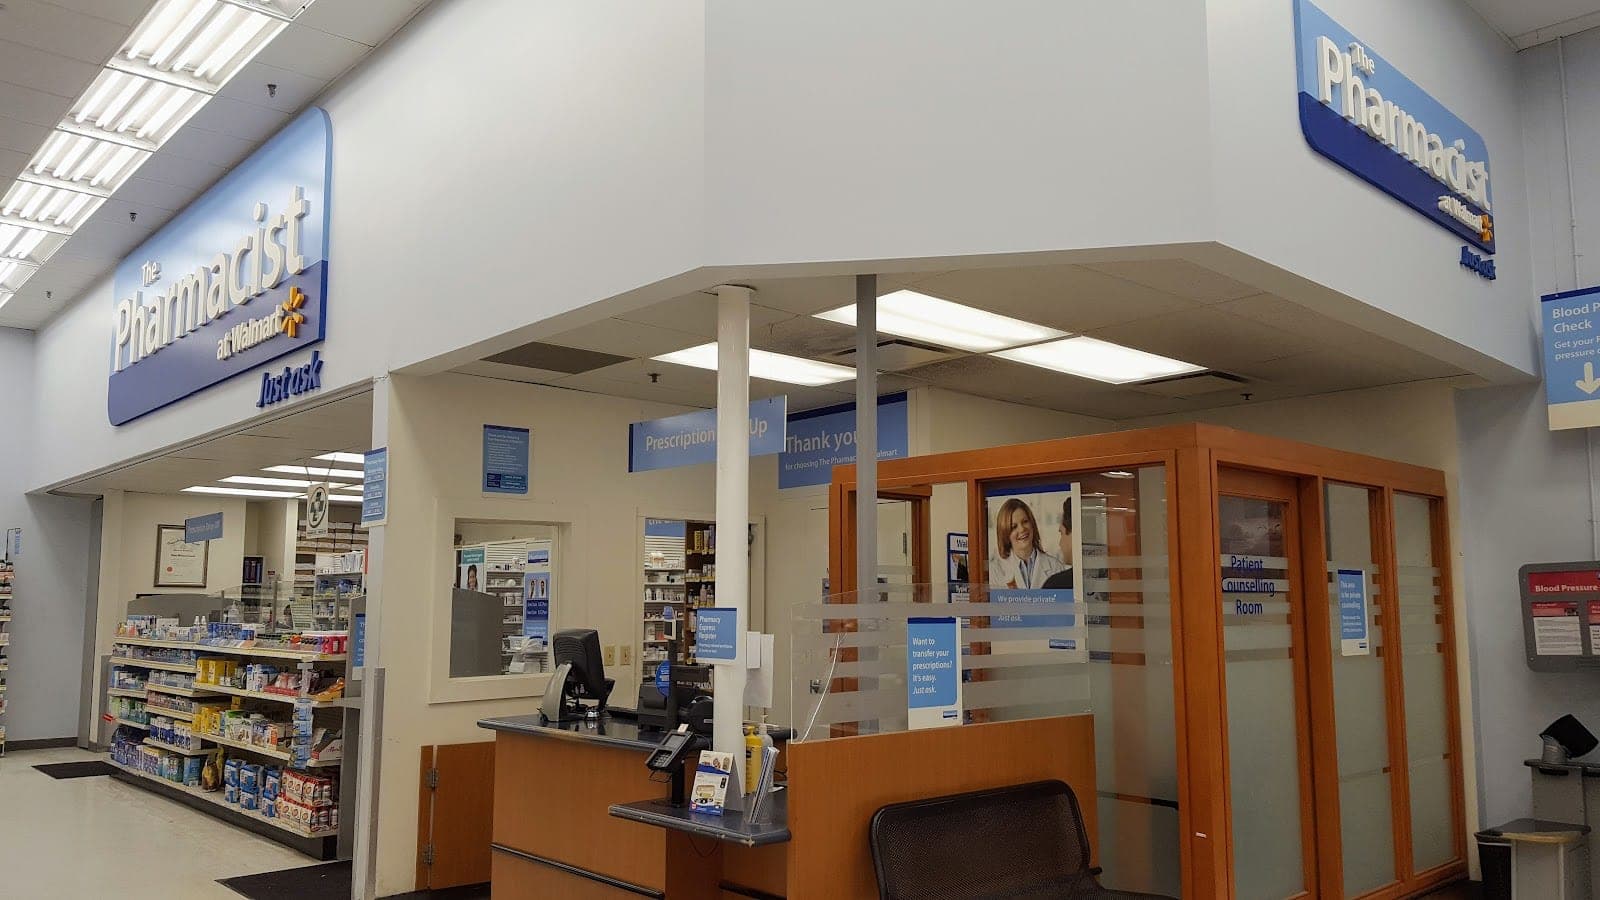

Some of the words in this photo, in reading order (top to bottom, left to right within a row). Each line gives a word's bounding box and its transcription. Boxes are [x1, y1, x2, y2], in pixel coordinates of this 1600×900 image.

[1350, 42, 1375, 76] The
[1317, 36, 1491, 211] Pharmacist
[113, 185, 310, 372] Pharmacist
[142, 260, 161, 287] The
[1552, 303, 1589, 319] Blood
[216, 332, 232, 360] at
[231, 304, 284, 353] Walmart
[1553, 319, 1592, 333] Check
[1554, 340, 1570, 349] Get
[1573, 338, 1593, 348] your
[1555, 349, 1595, 361] pressure
[256, 372, 292, 407] Just
[289, 350, 323, 396] ask
[646, 429, 715, 452] Prescription
[786, 430, 830, 454] Thank
[793, 460, 818, 470] choosing
[819, 458, 830, 466] The
[1231, 555, 1264, 569] Patient
[1222, 576, 1275, 597] Counselling
[1236, 599, 1263, 615] Room
[912, 638, 927, 646] Want
[928, 638, 935, 646] to
[936, 650, 949, 658] your
[912, 660, 953, 670] prescriptions?
[912, 686, 924, 695] Just
[924, 685, 937, 694] ask.
